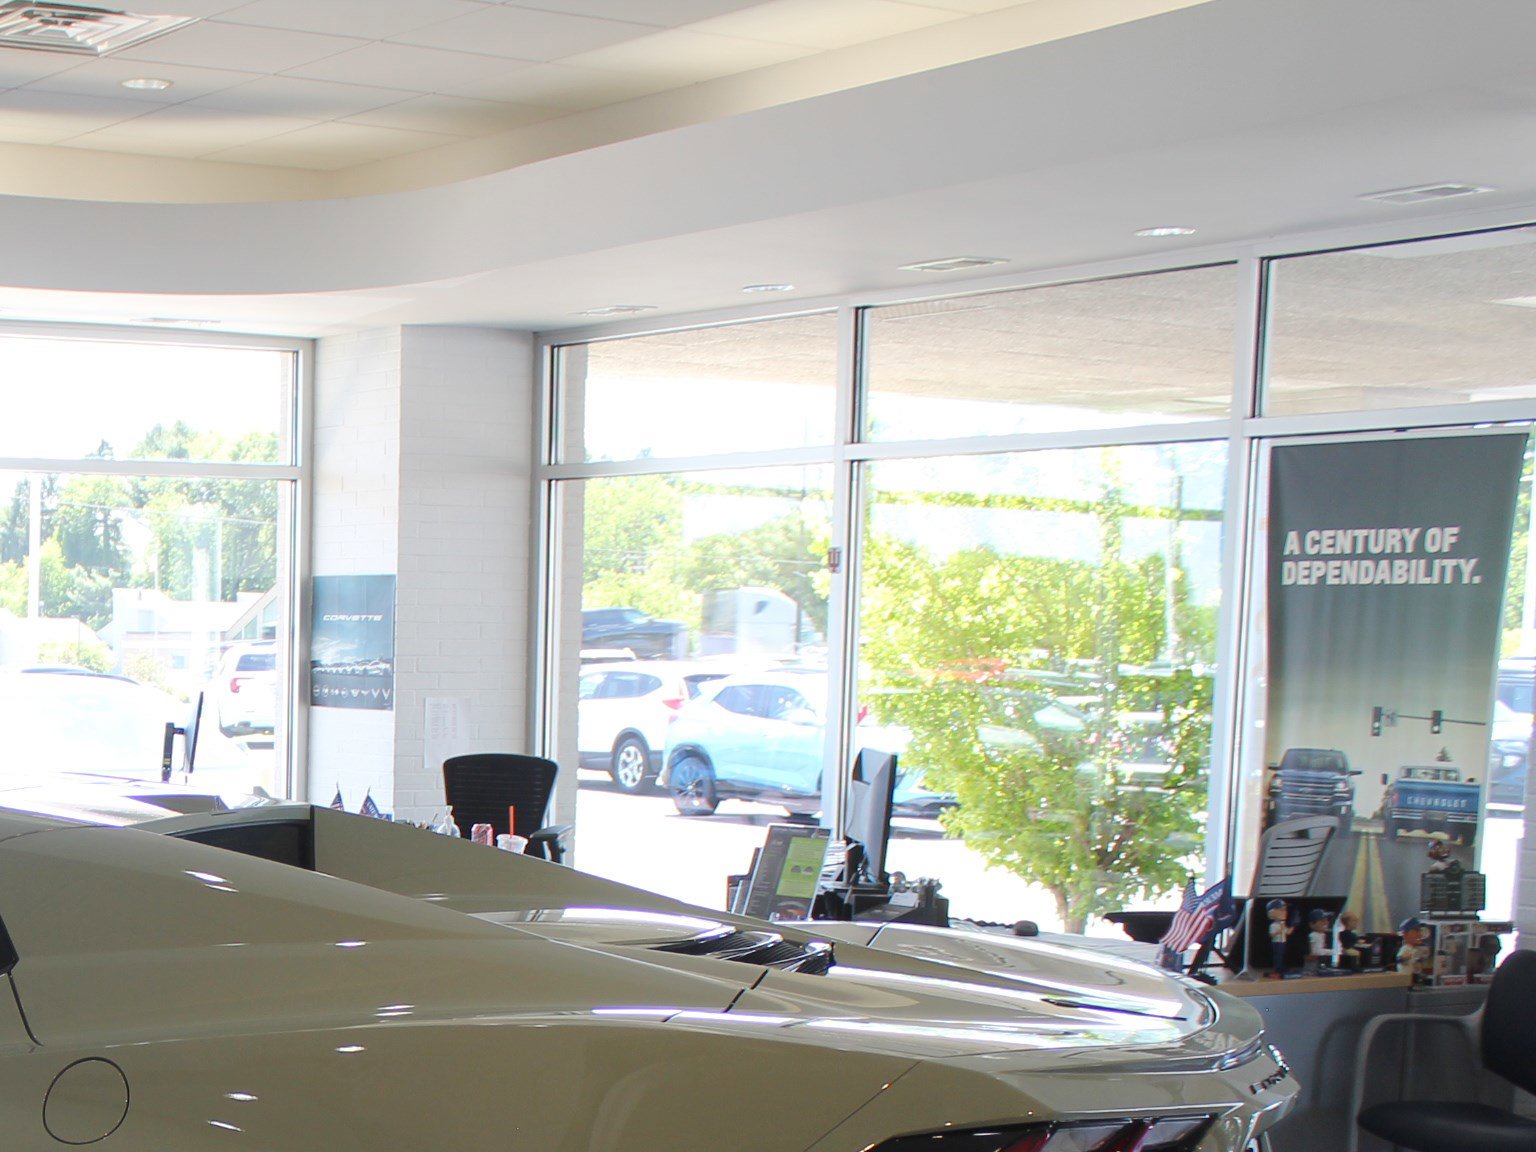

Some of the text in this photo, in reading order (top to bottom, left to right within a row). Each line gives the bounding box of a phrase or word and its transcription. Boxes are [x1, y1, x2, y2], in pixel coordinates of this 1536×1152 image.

[1283, 526, 1461, 555] A CENTURY OF
[1281, 558, 1484, 586] DEPENDABILITY.
[323, 614, 383, 622] CORVETTE
